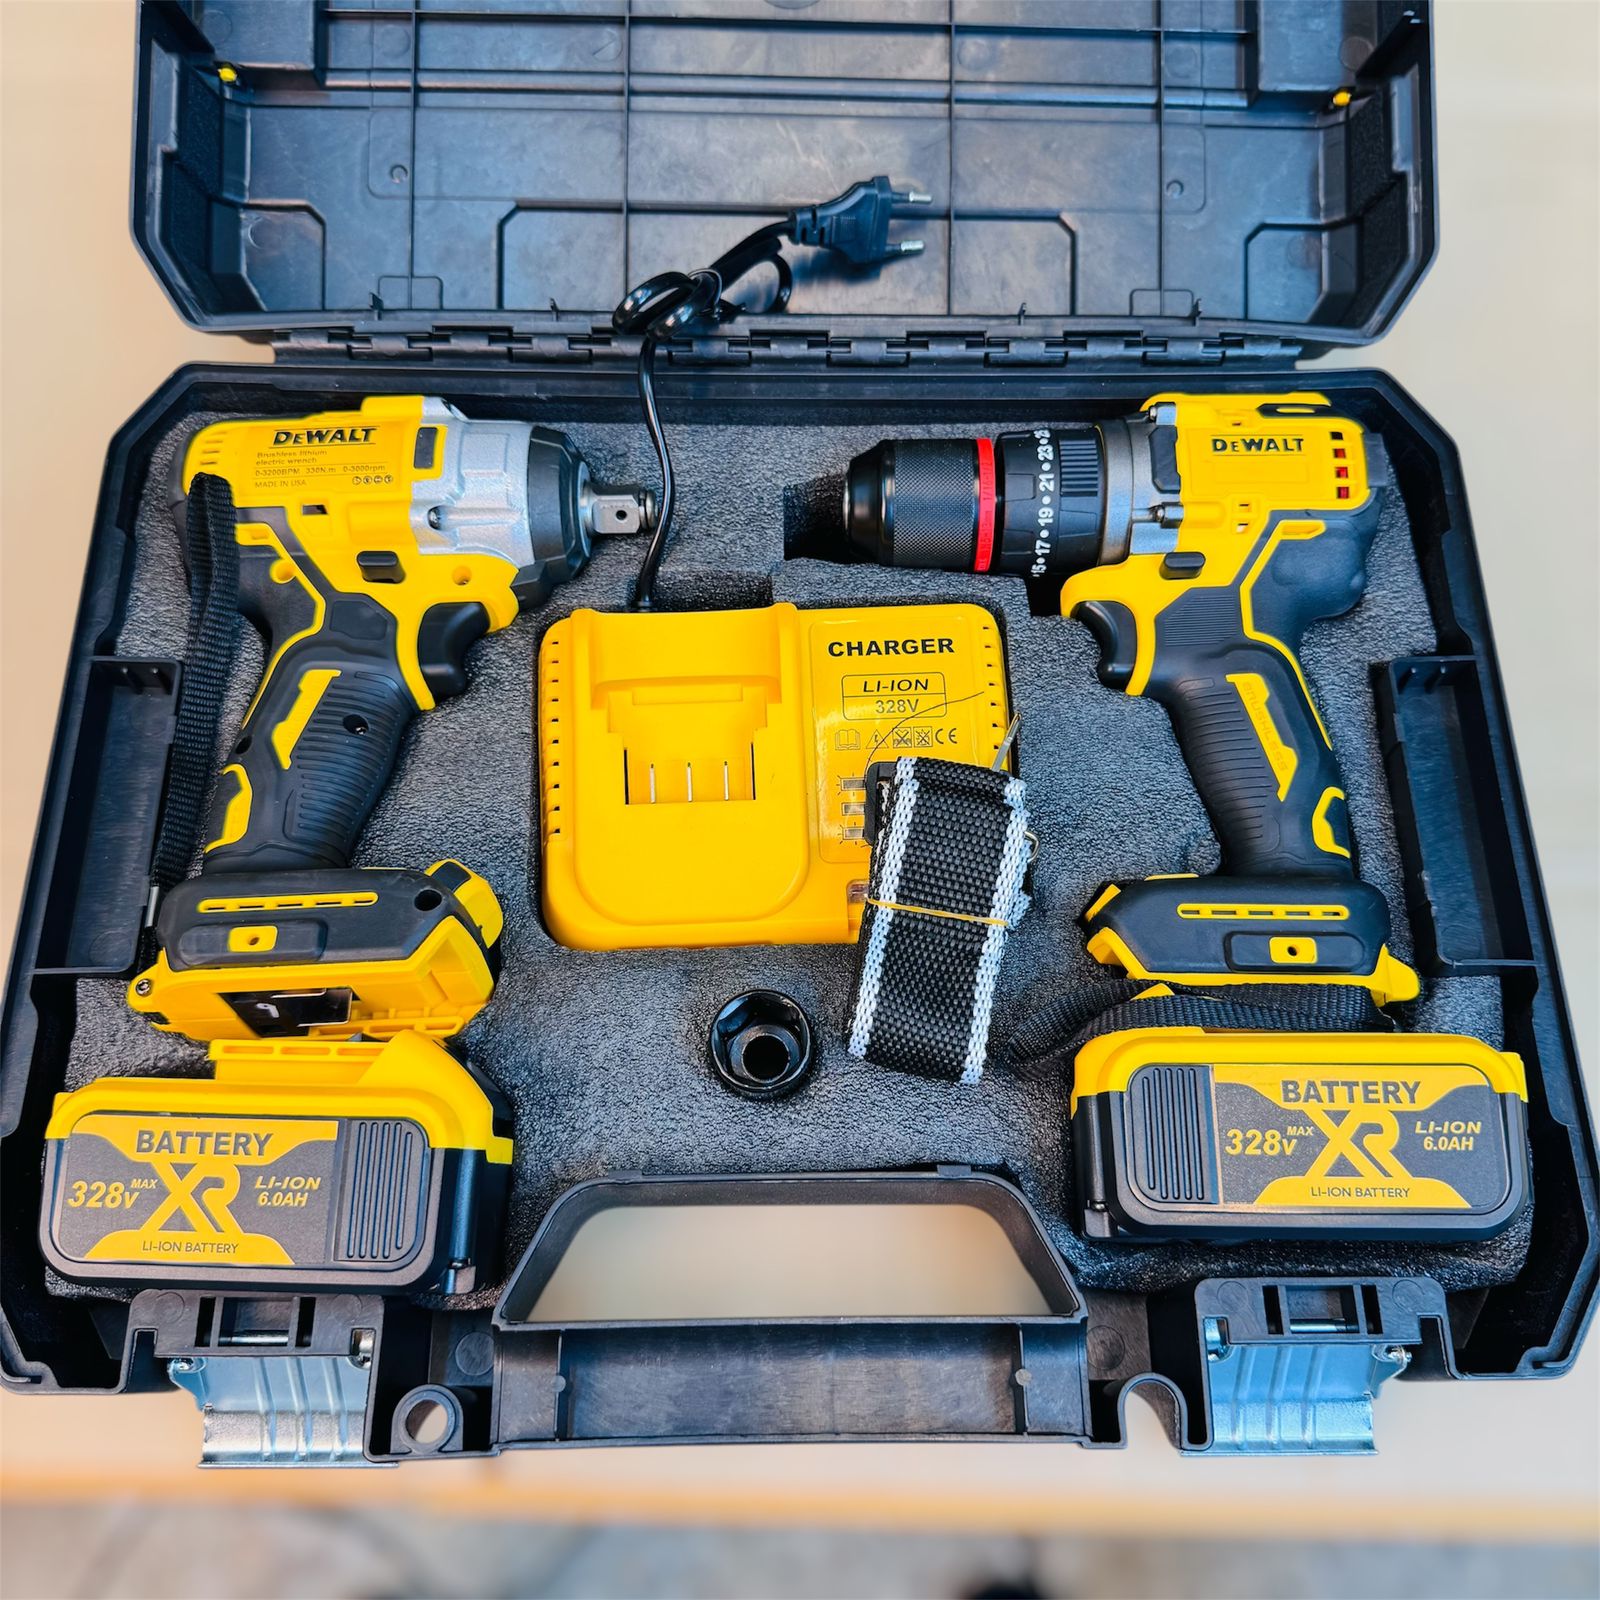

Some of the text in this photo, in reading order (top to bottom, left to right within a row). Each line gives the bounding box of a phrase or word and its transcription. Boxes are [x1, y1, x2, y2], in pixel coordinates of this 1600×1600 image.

[1037, 444, 1054, 461] 23
[256, 458, 285, 466] electric
[254, 480, 279, 488] MADE
[291, 479, 307, 487] USA
[1038, 472, 1055, 492] 21
[1038, 507, 1054, 527] 19
[1034, 539, 1052, 556] 17
[828, 638, 955, 657] CHARGER
[863, 678, 929, 693] LI-ION
[875, 698, 919, 714] 328V
[1280, 1080, 1422, 1105] BATTERY
[1286, 1126, 1314, 1136] MAX
[1414, 1120, 1482, 1135] LI-ION
[136, 1129, 273, 1156] BATTERY
[1422, 1136, 1474, 1151] 6.0AH
[130, 1178, 158, 1189] MAX
[254, 1175, 322, 1190] LI-ION
[258, 1191, 309, 1208] 6.0AH
[1310, 1186, 1411, 1199] LI-ION BATTERY
[142, 1240, 240, 1254] LI-ION BATTERY
